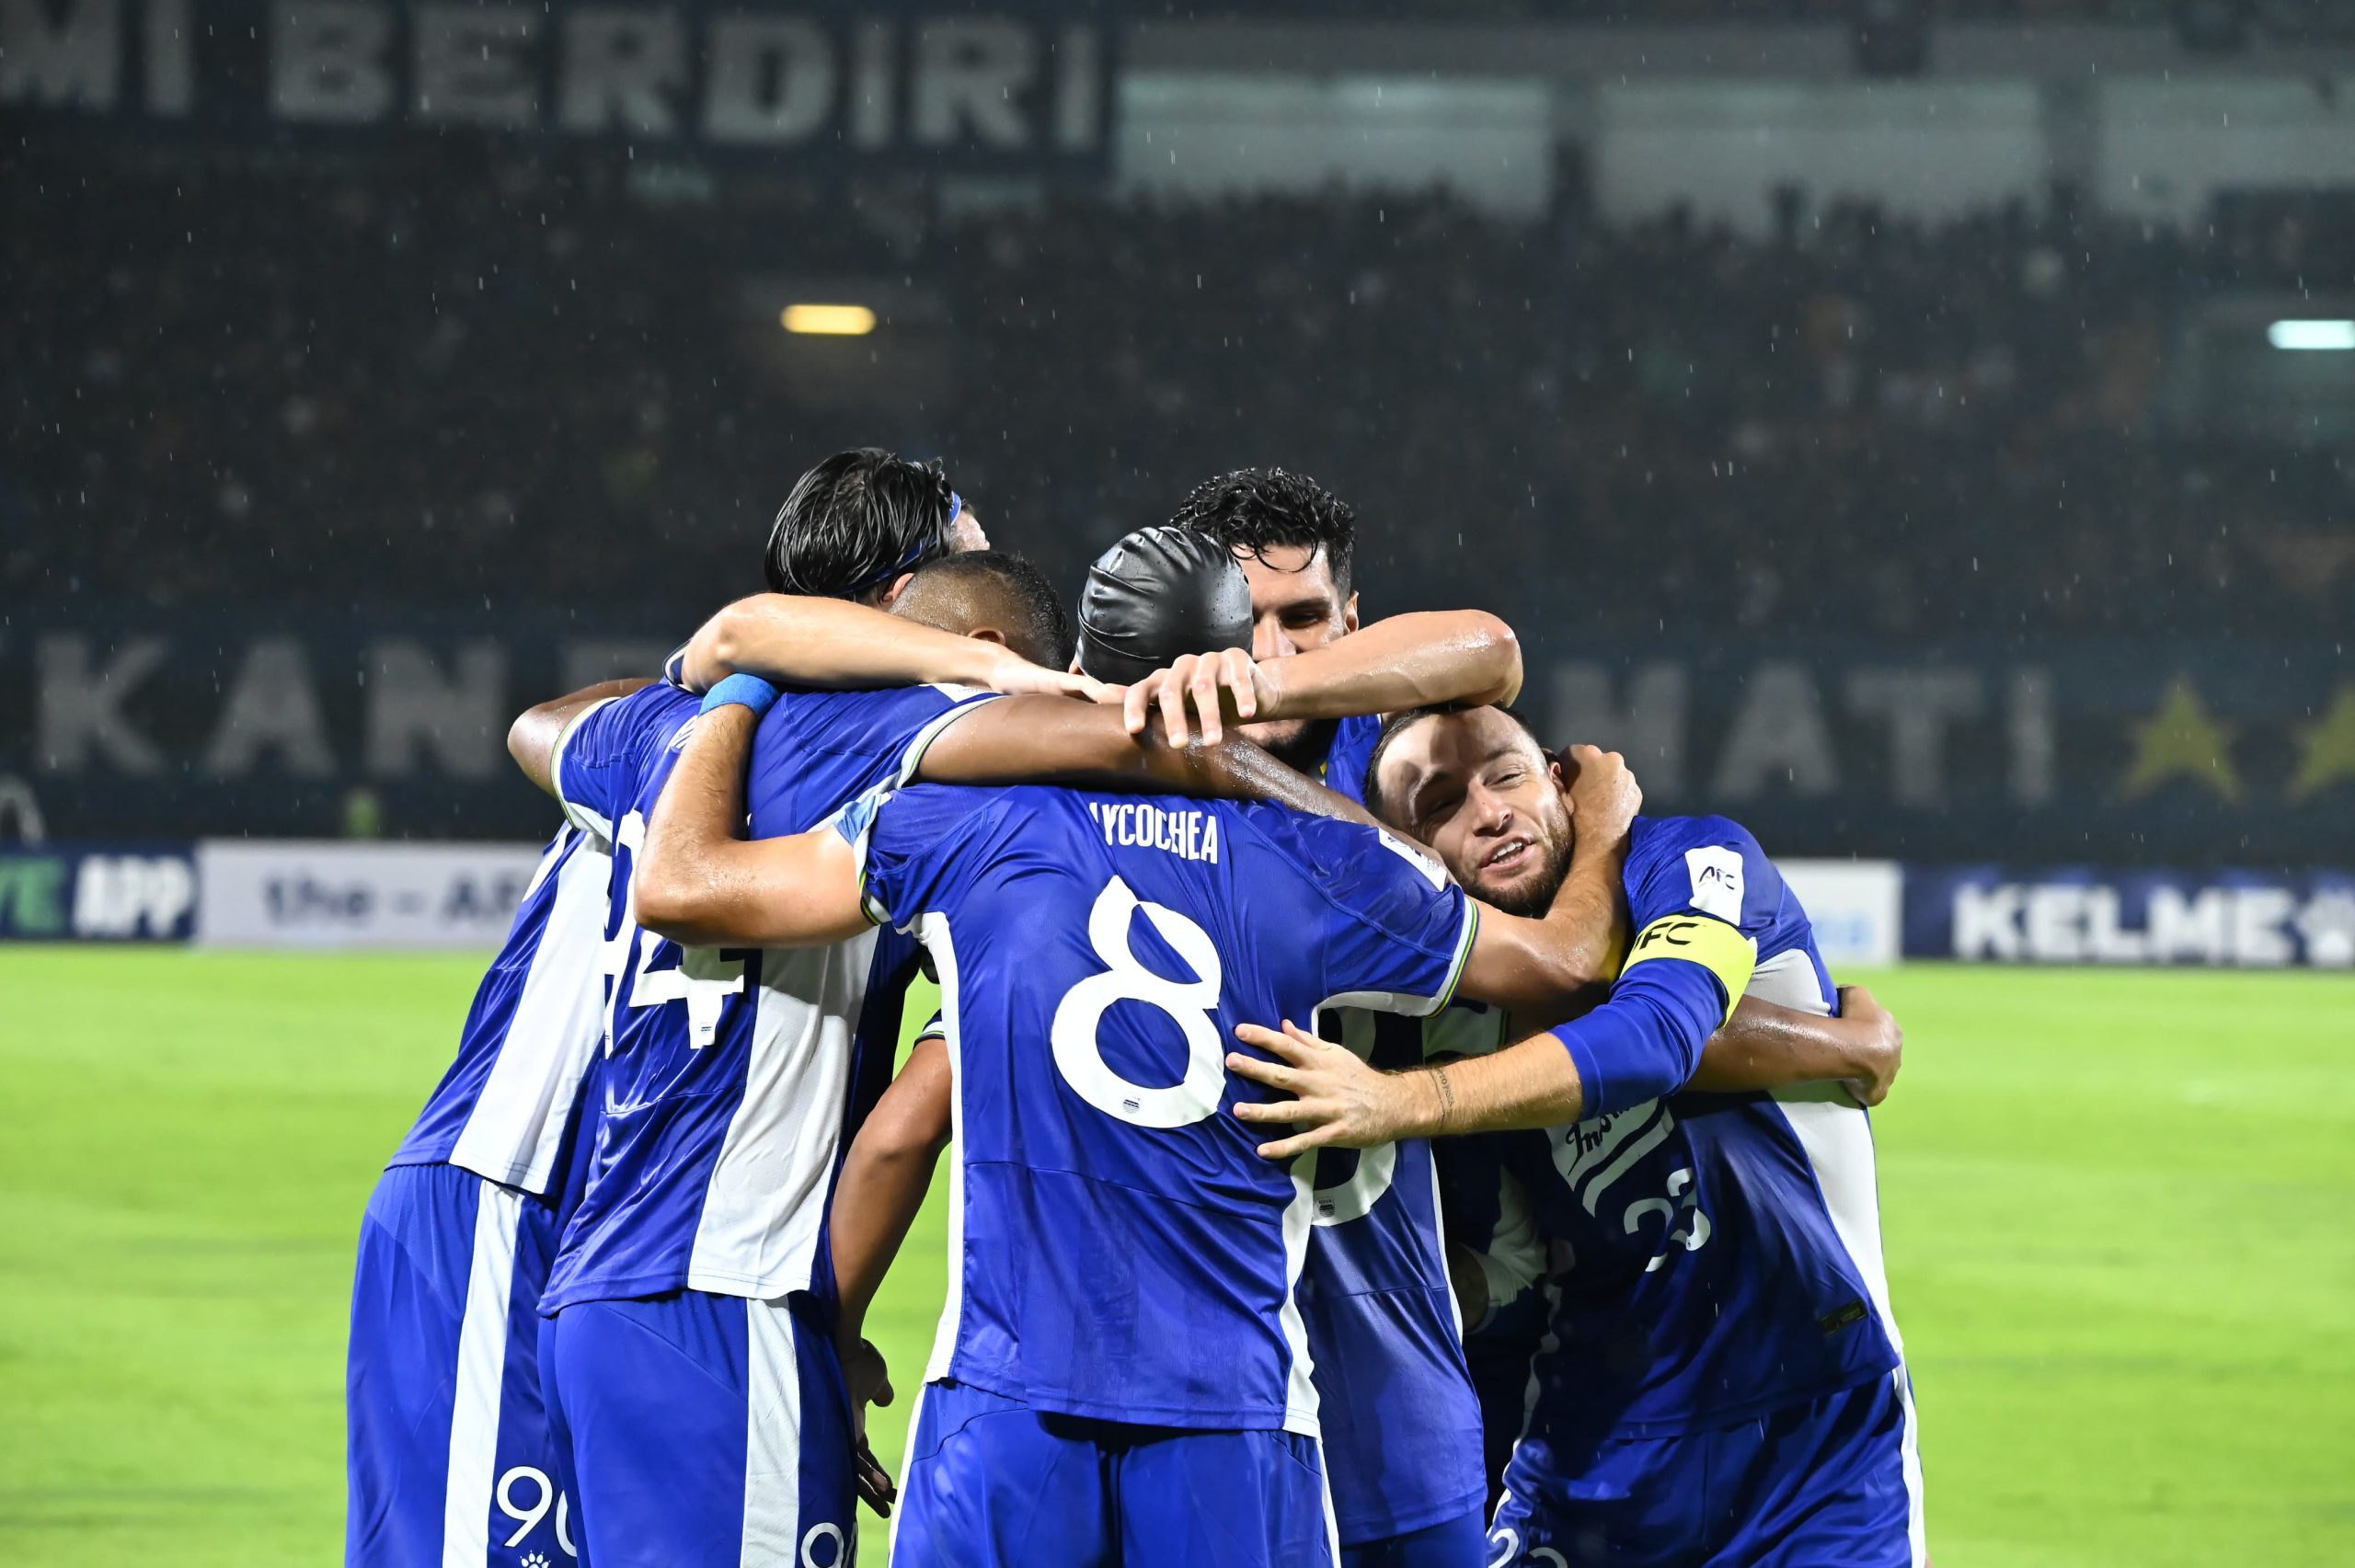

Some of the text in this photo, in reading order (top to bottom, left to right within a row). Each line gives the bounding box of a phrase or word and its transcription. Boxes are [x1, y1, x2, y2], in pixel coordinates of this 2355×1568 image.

[269, 0, 1099, 152] BERDIRI
[1089, 802, 1218, 864] YCOCHEA
[74, 855, 193, 936] APP
[1948, 881, 2294, 963] KELME
[1633, 921, 1700, 952] FC
[1051, 875, 1226, 1128] 8
